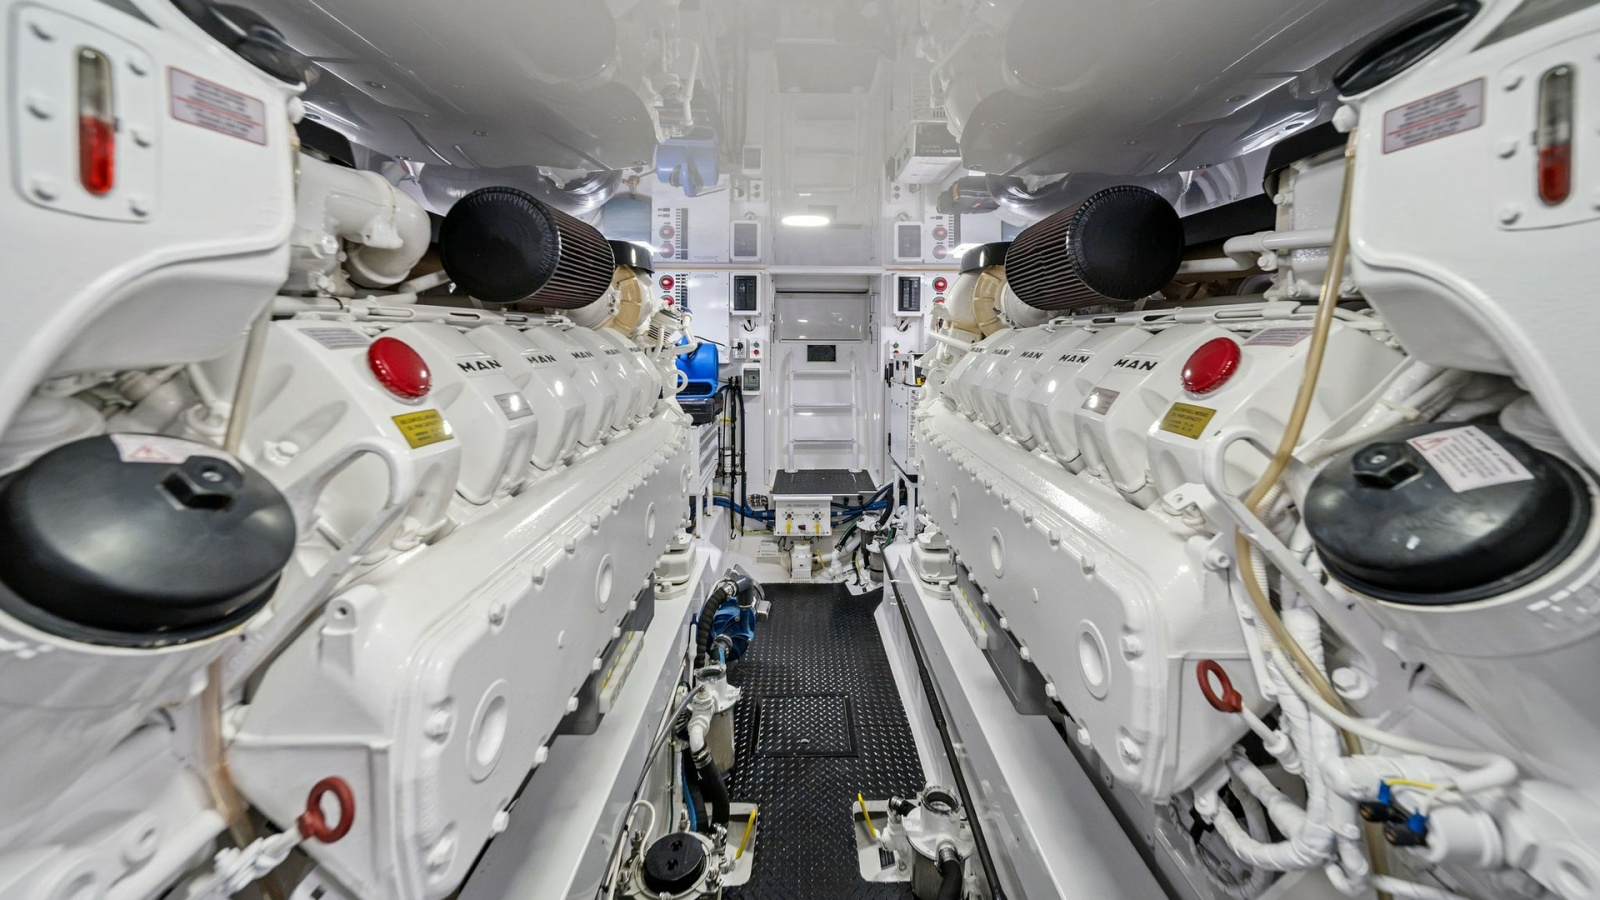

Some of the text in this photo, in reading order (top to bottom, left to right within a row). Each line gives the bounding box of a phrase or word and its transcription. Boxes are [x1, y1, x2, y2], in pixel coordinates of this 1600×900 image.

[527, 354, 557, 364] MAN
[571, 351, 593, 359] MAN
[1020, 351, 1043, 359] MAN
[1058, 354, 1090, 363] MAN
[457, 359, 502, 372] MAN
[1113, 358, 1158, 371] MAN
